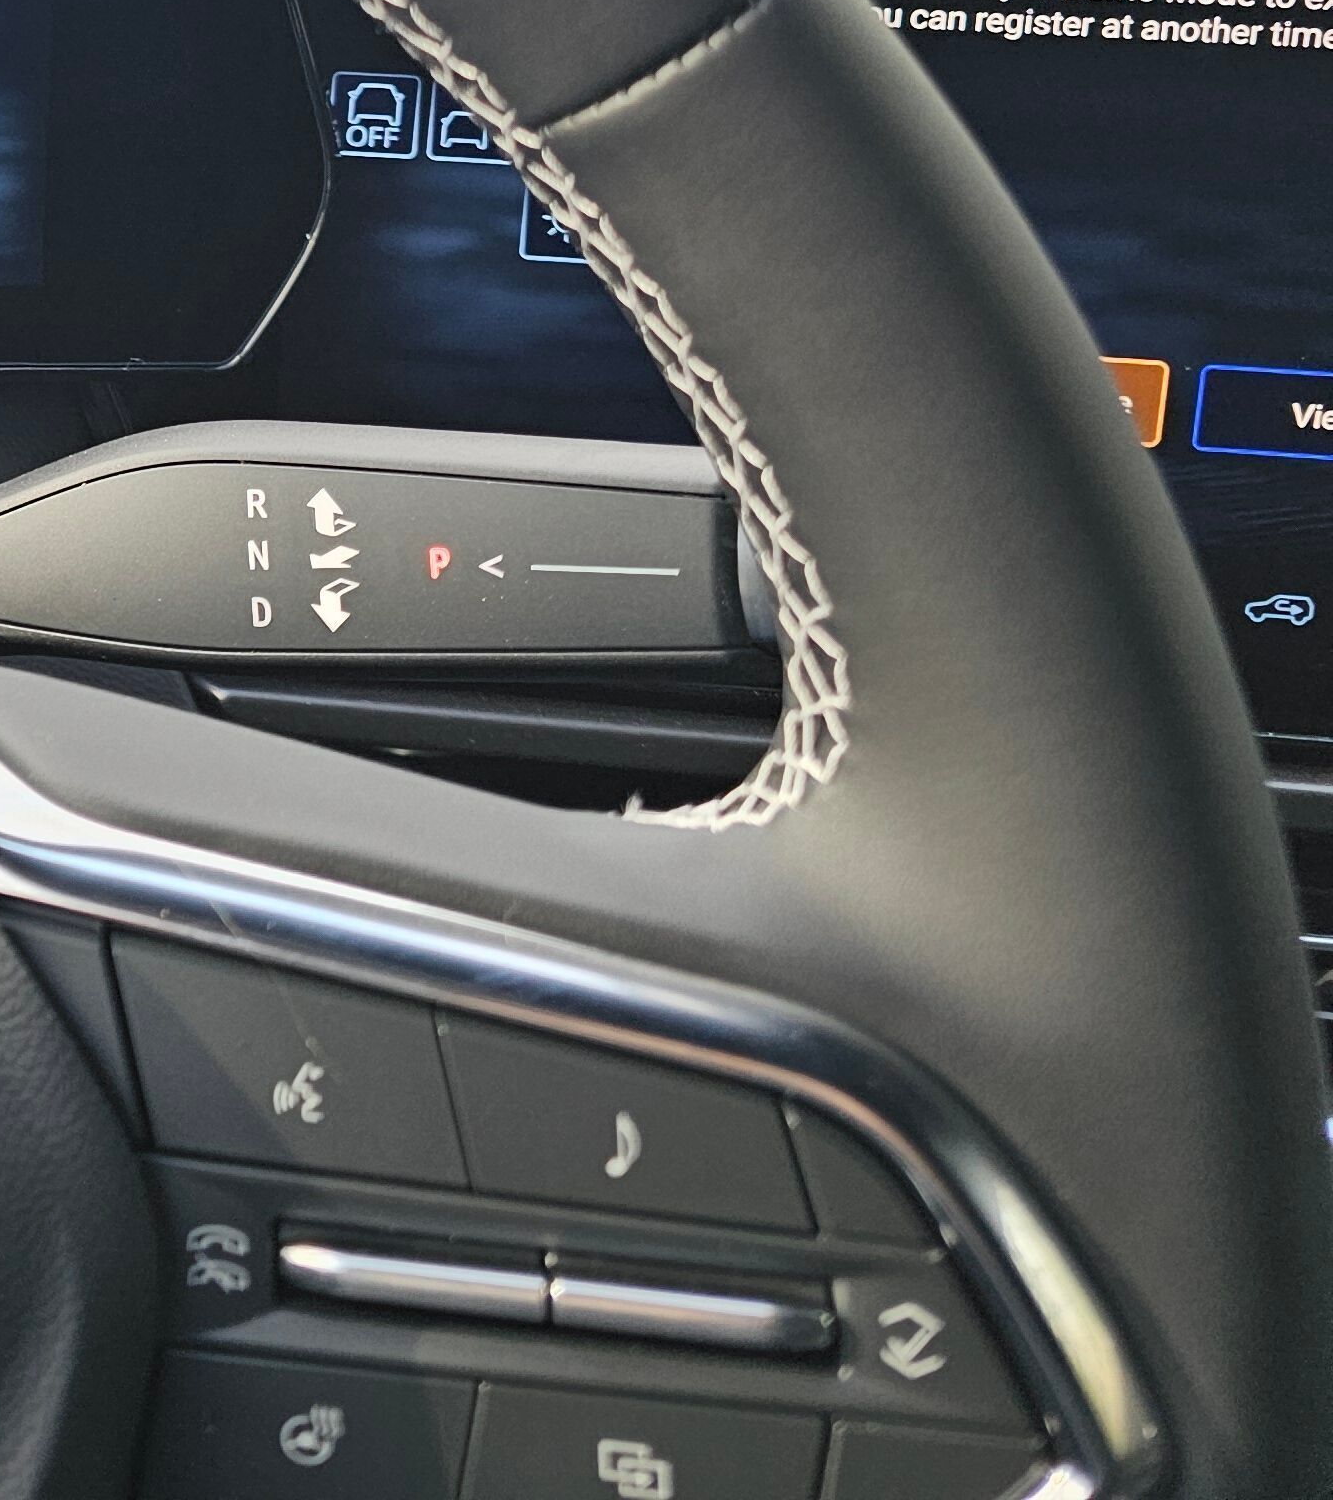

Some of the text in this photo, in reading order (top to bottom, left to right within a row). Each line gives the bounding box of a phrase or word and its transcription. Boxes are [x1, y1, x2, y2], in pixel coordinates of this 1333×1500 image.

[909, 8, 968, 32] can
[974, 8, 1096, 41] register
[1101, 14, 1135, 40] at
[1140, 15, 1265, 46] another
[343, 124, 403, 149] OFF
[1291, 402, 1333, 431] Vie
[246, 488, 268, 519] R
[247, 539, 270, 571] N
[428, 547, 451, 580] P
[251, 596, 272, 628] D
